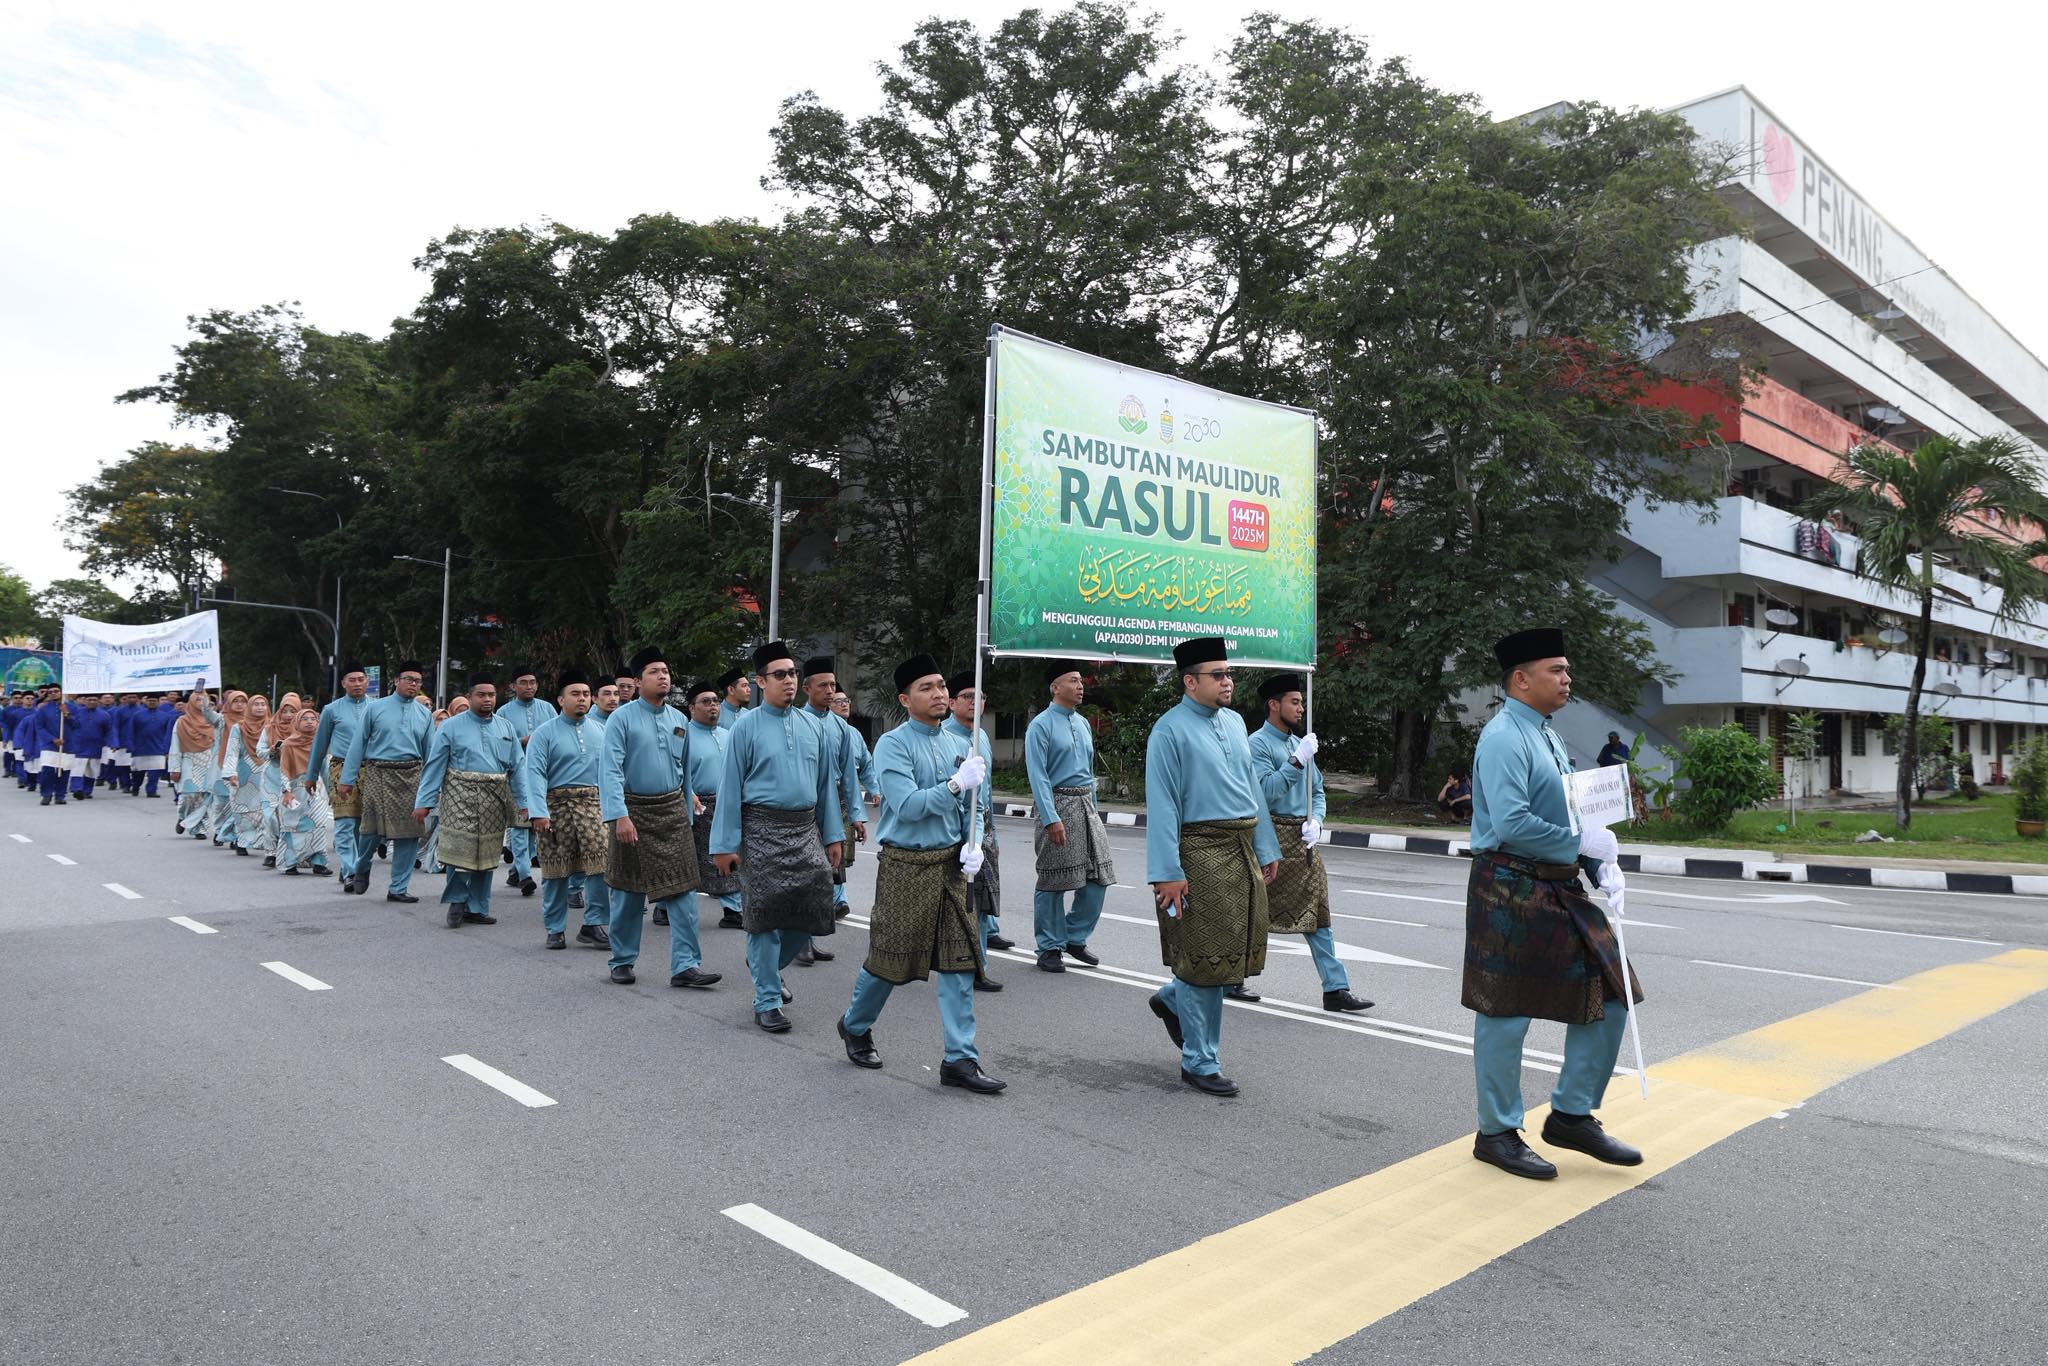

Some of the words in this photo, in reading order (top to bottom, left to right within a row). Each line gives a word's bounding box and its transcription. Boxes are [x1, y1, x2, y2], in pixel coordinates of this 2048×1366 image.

[1803, 154, 1883, 284] PENANG
[1183, 417, 1222, 442] 2030
[1042, 429, 1171, 478] SAMBUTAN
[1177, 456, 1281, 498] MAULIDUR
[1058, 465, 1221, 546] RASUL
[1231, 507, 1265, 526] 1447H
[1231, 526, 1265, 543] 2025M
[1042, 611, 1116, 628] MENGUNGGULI
[1117, 617, 1157, 631] AGENDA
[1158, 620, 1224, 635] PEMBANGUNAN
[1225, 625, 1255, 637] AGAMA
[1256, 627, 1278, 638] ISLAM
[110, 643, 172, 657] Maulidur
[177, 638, 213, 652] Rasul
[1094, 630, 1144, 646] (APAI2030)
[1145, 634, 1168, 646] DEMI
